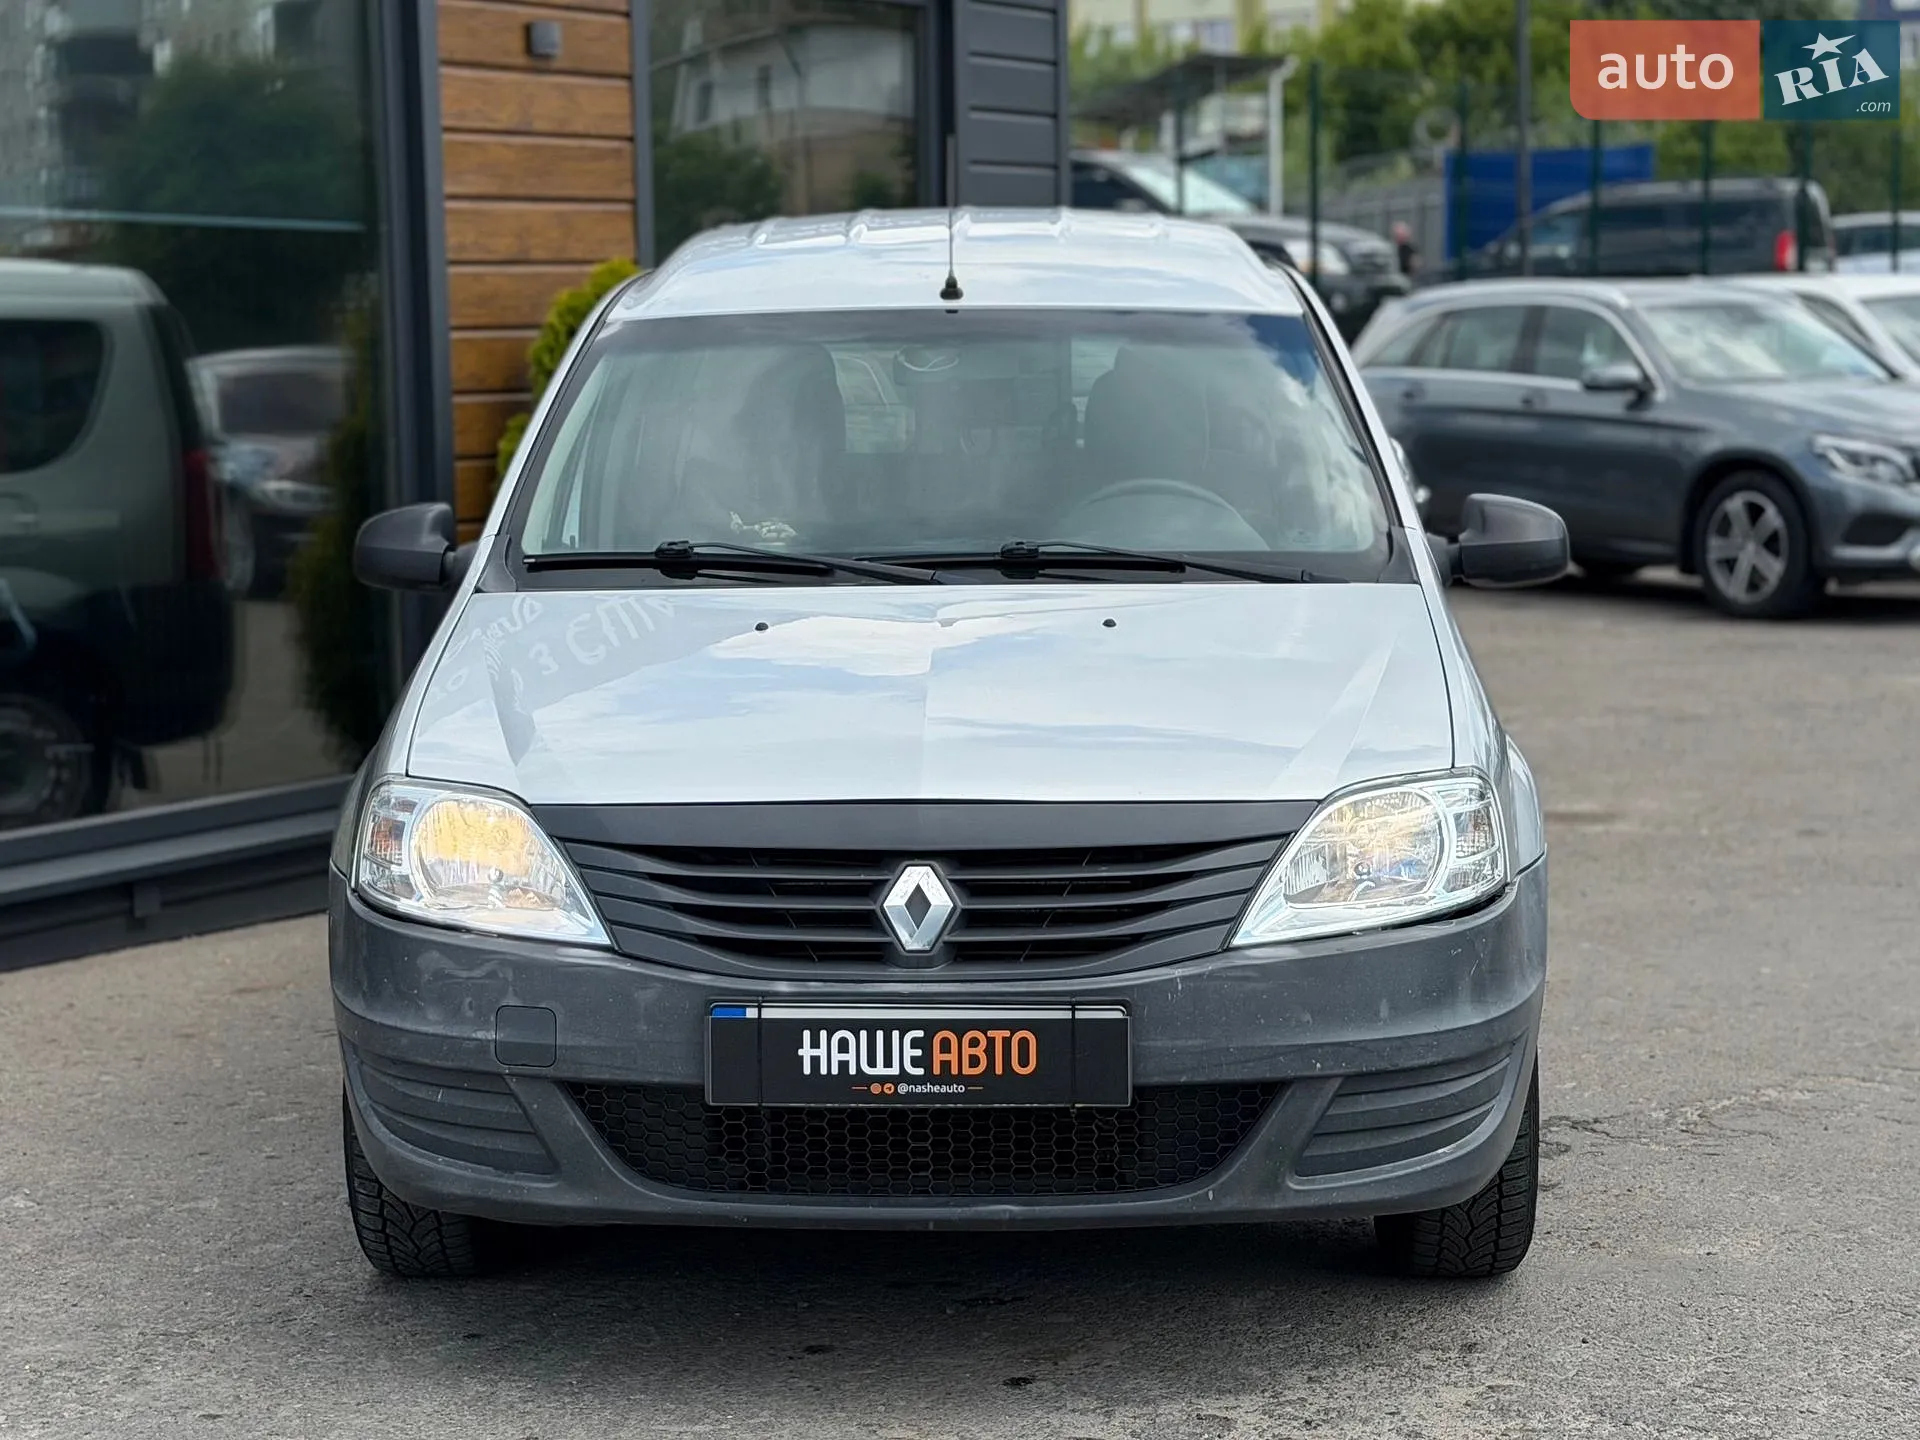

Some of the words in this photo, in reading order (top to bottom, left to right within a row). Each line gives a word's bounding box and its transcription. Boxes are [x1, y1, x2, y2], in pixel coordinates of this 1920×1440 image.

[798, 1029, 925, 1075] НАШЕ
[932, 1029, 1037, 1075] АВТО
[897, 1082, 966, 1094] @nasheauto
